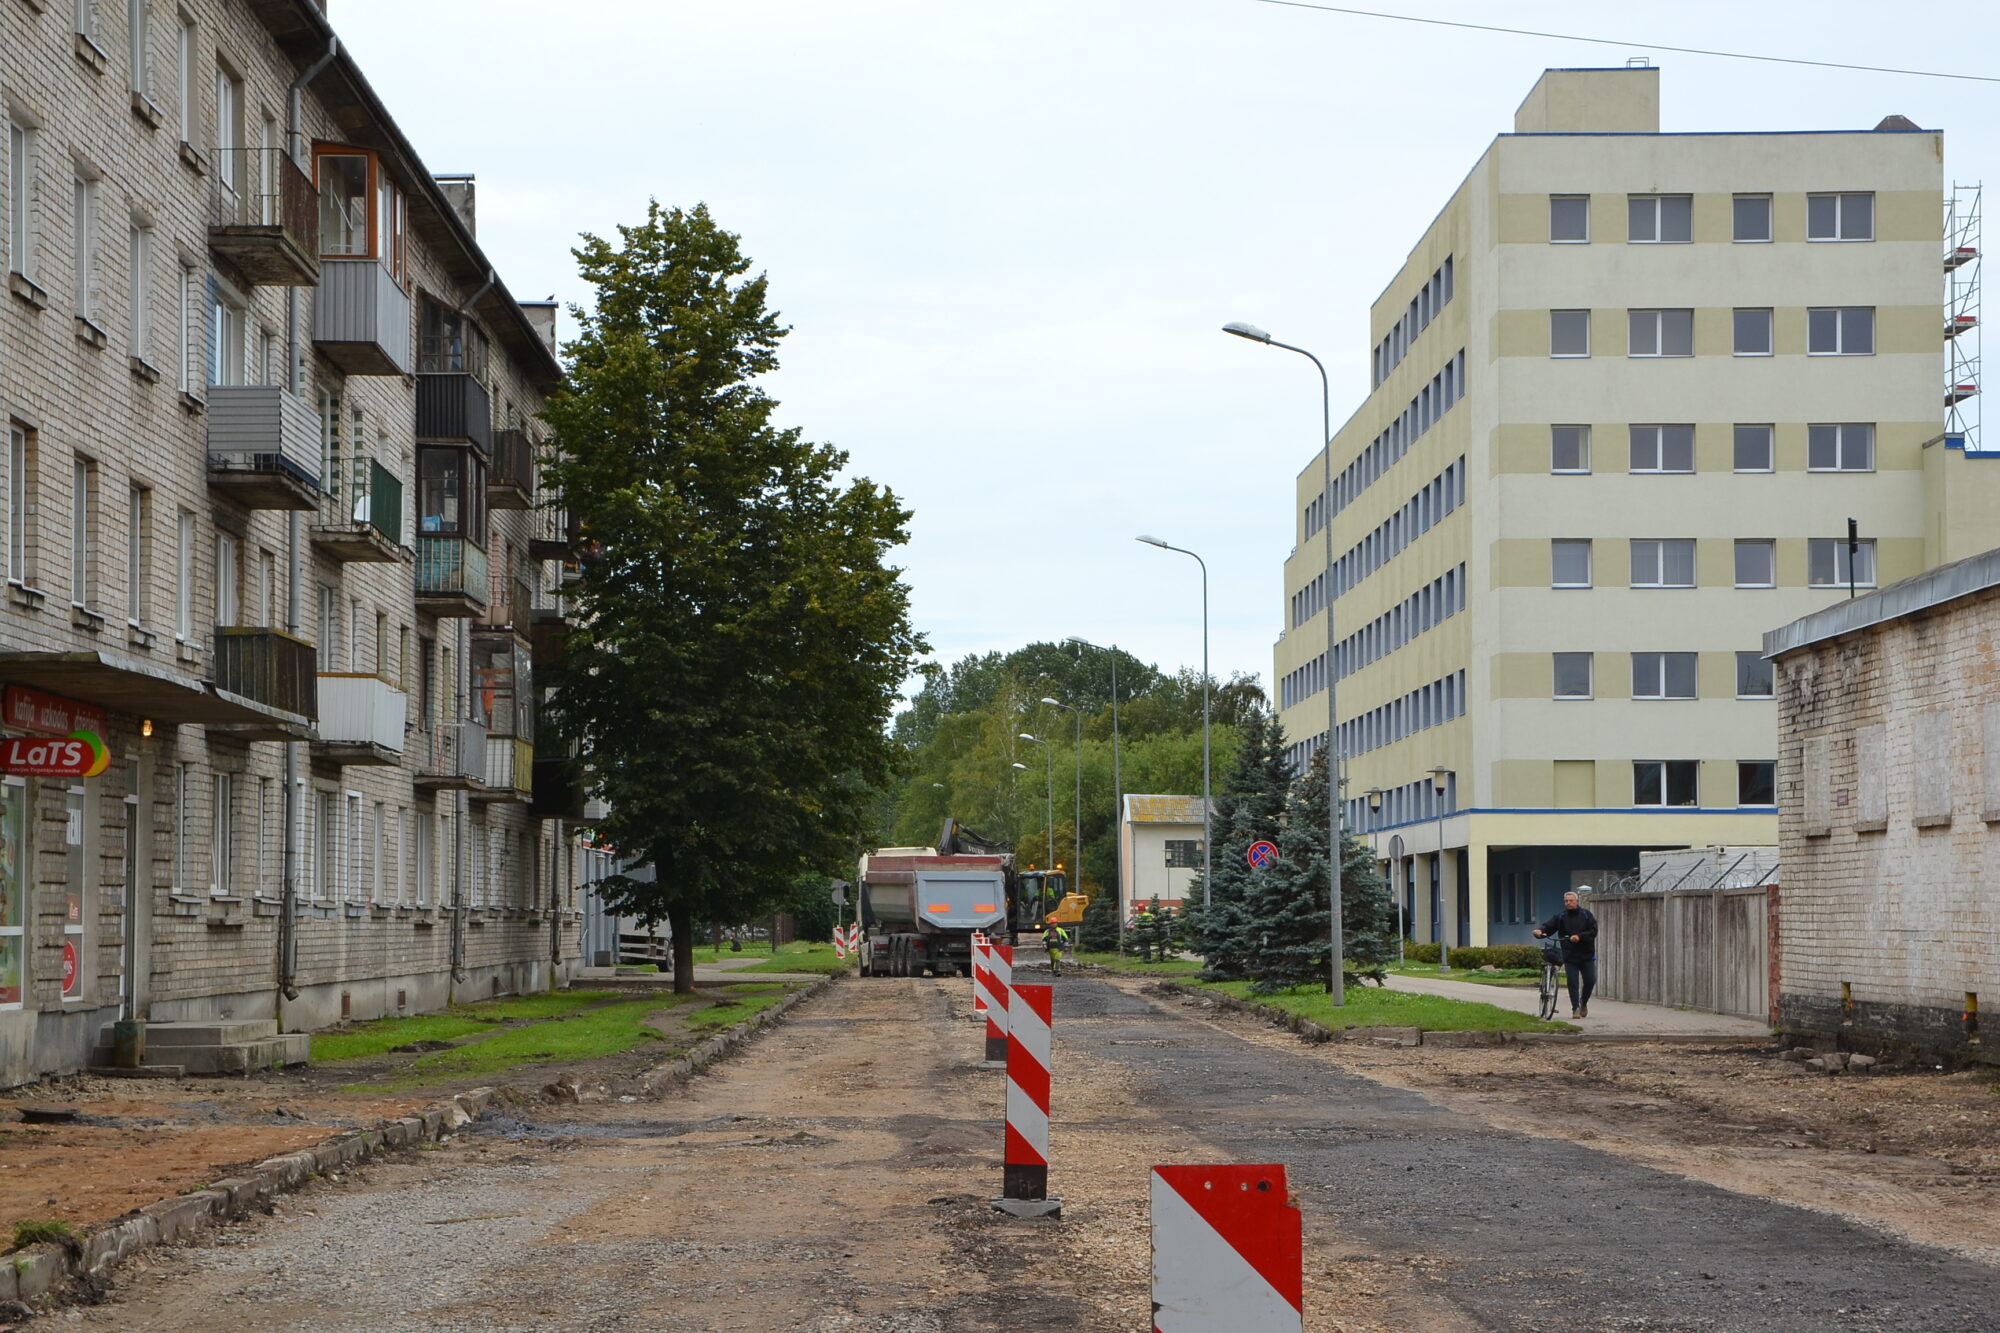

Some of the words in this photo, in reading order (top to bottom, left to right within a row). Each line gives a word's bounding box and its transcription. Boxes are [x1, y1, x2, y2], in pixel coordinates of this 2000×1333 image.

[14, 693, 35, 728] kafija
[41, 702, 68, 730] uzkodas
[10, 741, 82, 766] LaTS
